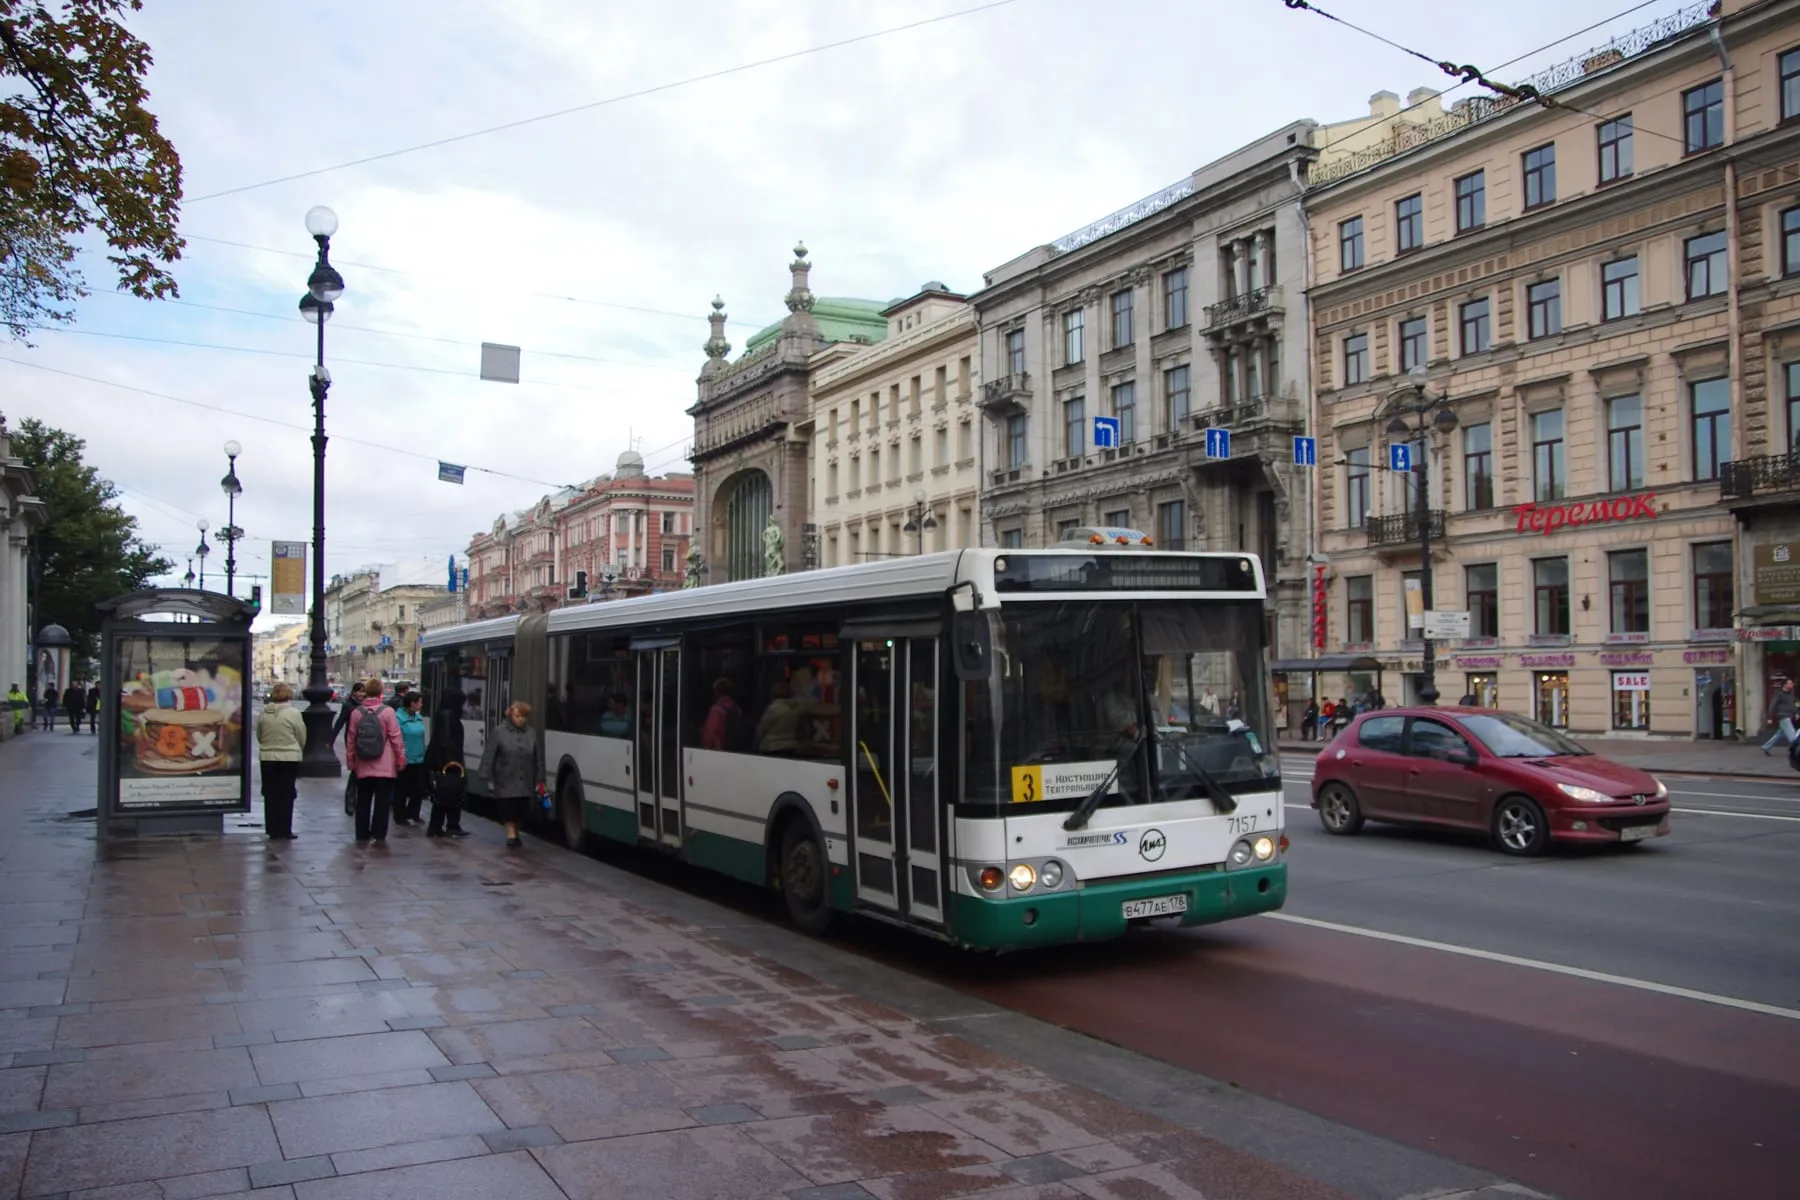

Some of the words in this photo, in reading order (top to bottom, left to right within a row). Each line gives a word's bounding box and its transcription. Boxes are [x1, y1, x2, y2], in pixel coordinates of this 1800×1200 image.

[1511, 492, 1658, 536] Теремок
[1618, 676, 1648, 686] SALE
[1022, 773, 1035, 802] 3
[1227, 815, 1257, 834] 7157
